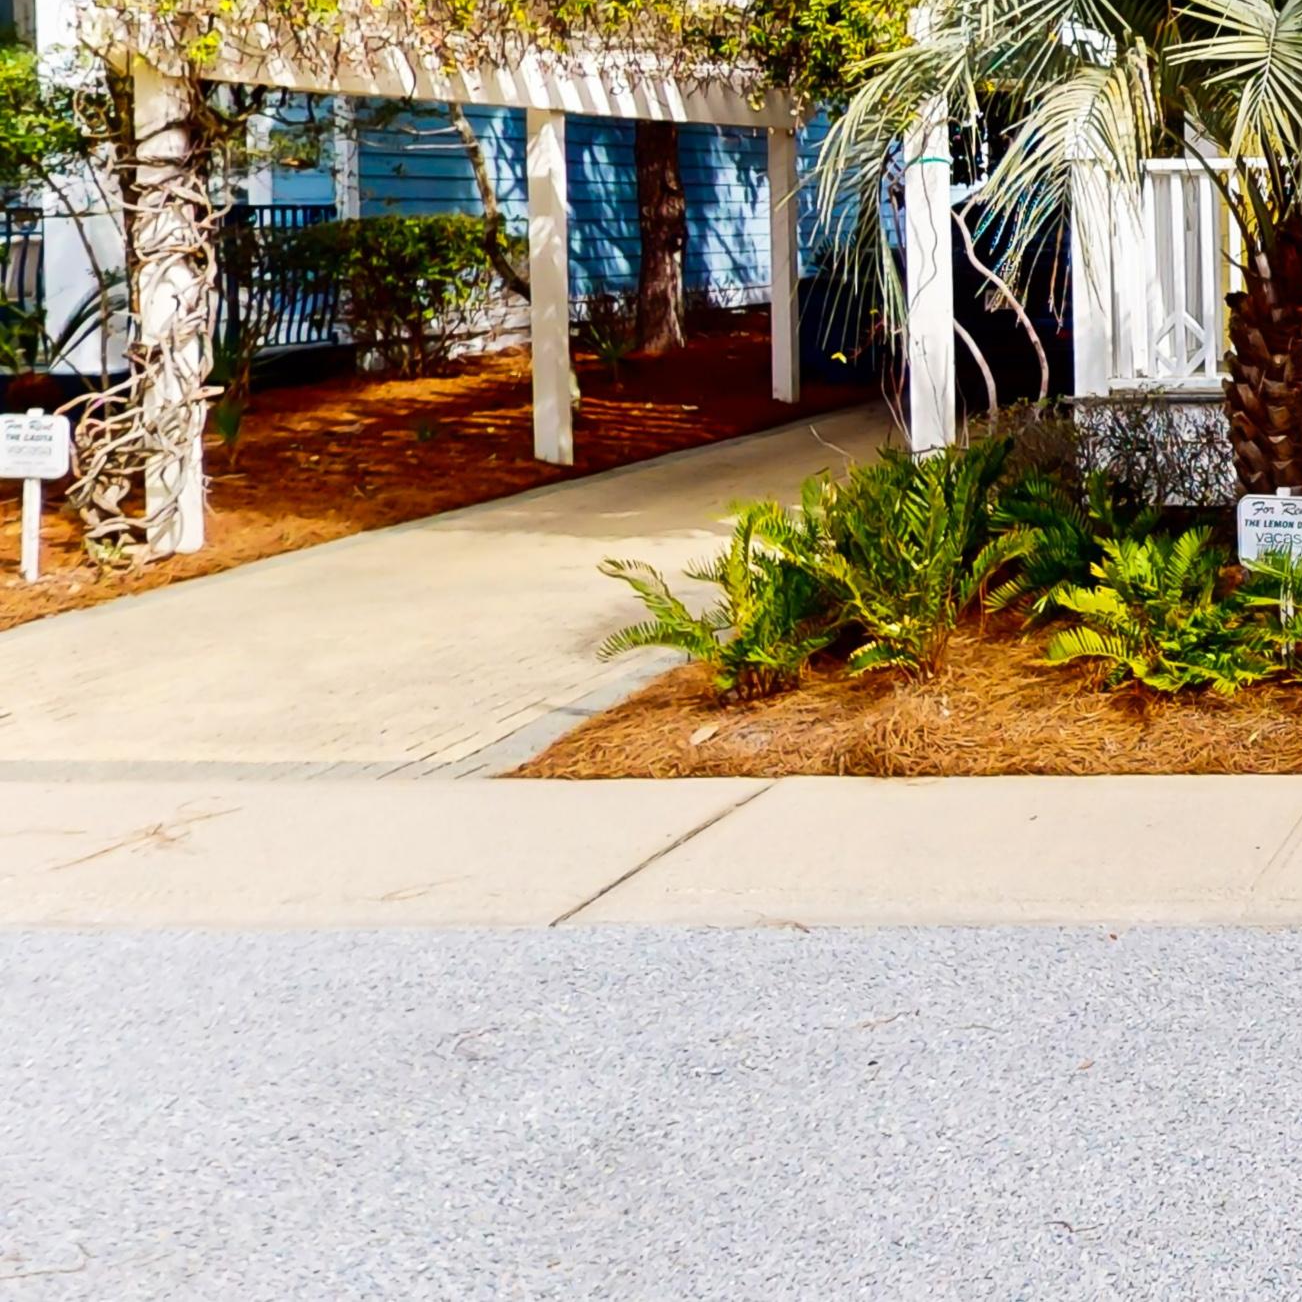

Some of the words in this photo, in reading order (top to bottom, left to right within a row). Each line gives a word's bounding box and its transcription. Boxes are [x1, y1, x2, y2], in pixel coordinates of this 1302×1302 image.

[1251, 501, 1275, 515] For
[1244, 519, 1260, 527] THE
[1264, 520, 1294, 529] LEMON
